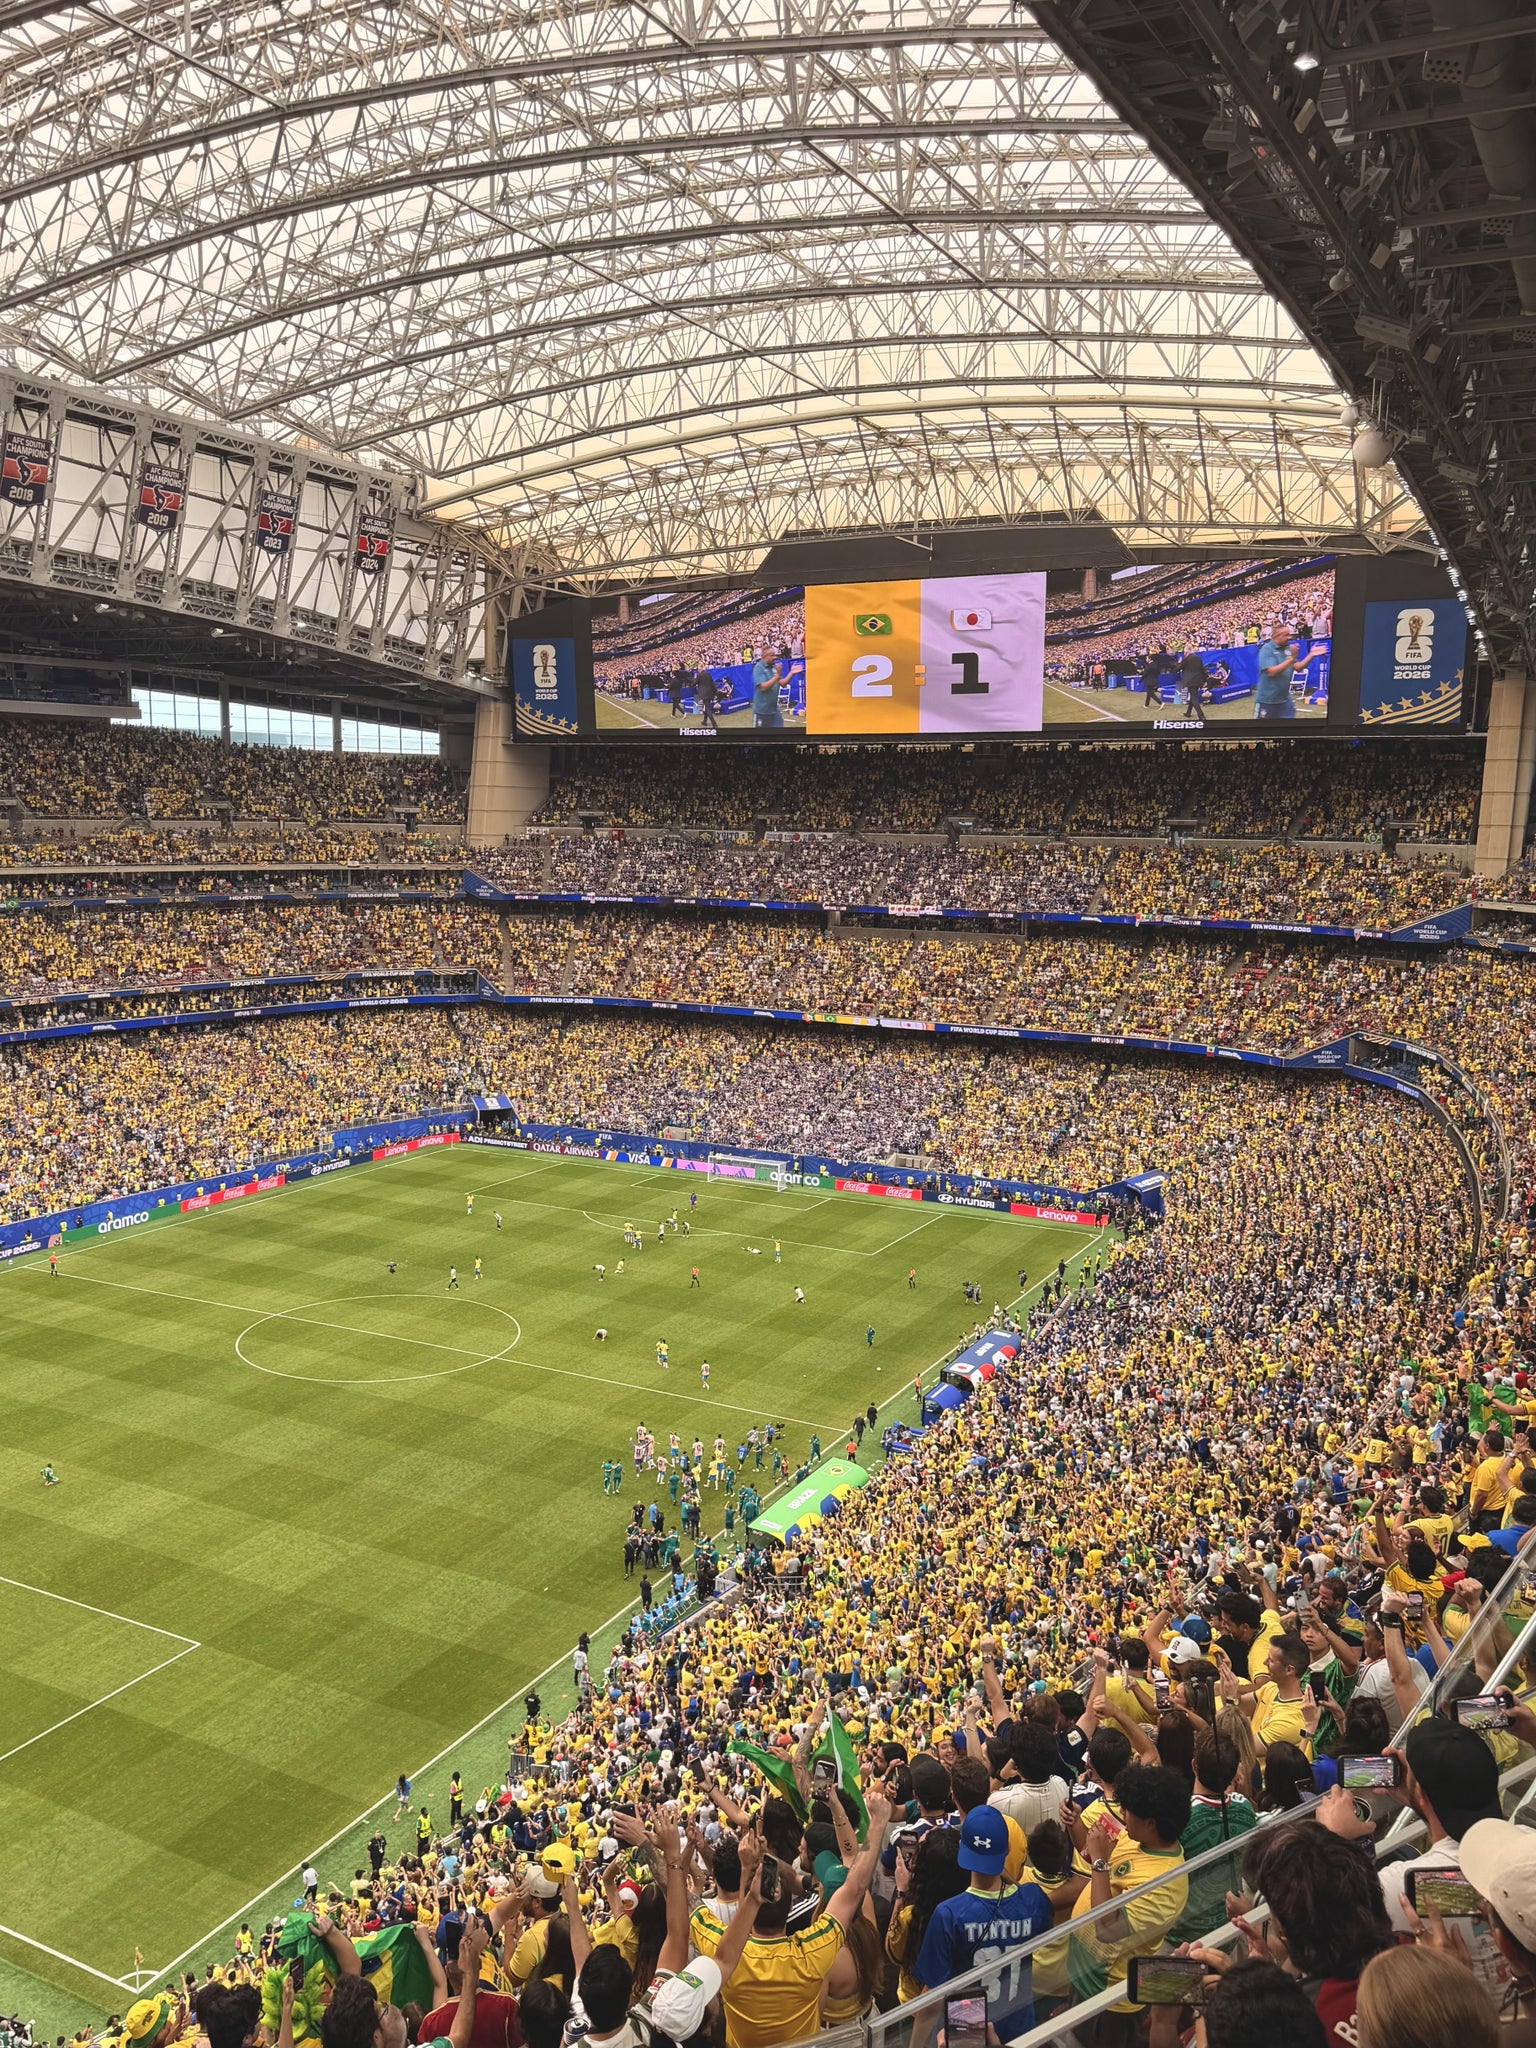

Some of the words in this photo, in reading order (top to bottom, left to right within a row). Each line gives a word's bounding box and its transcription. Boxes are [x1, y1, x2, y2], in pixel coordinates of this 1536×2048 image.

[12, 436, 24, 445] AFC
[25, 440, 46, 450] SOUTH
[6, 442, 49, 459] CHAMPIONS
[150, 466, 161, 475] AFC
[162, 469, 180, 479] SOUTH
[145, 472, 183, 488] CHAMPIONS
[9, 485, 34, 501] 2018
[267, 494, 277, 502] AFC
[277, 496, 292, 505] SOUTH
[262, 499, 294, 514] CHAMPIONS
[147, 511, 169, 527] 2019
[361, 522, 390, 535] CHAMPIONS
[263, 535, 282, 550] 2023
[360, 557, 379, 570] 2024
[851, 654, 894, 698] 2
[951, 652, 990, 695] 1
[1393, 670, 1431, 680] 2026
[1153, 719, 1204, 729] Hisense
[679, 727, 717, 736] Hisense
[230, 979, 266, 987] HOUSTON
[963, 1026, 985, 1034] WORLD
[1091, 1036, 1125, 1044] HOUSTON
[418, 1136, 444, 1148] Lenovo
[468, 1135, 483, 1144] ADI
[385, 1144, 409, 1157] Lenovo
[533, 1142, 561, 1154] QATAR
[564, 1145, 600, 1158] AIRWAYS
[627, 1152, 651, 1165] VISA
[275, 1162, 290, 1173] FIA
[323, 1159, 351, 1172] HYUNDAI
[770, 1171, 820, 1187] aramco
[975, 1180, 992, 1188] FIFA
[843, 1180, 869, 1193] Coca-Cola
[885, 1186, 912, 1199] Coca-Cola
[955, 1196, 995, 1209] HYUNDAI
[1036, 1207, 1078, 1223] Lenovo
[98, 1211, 149, 1234] aramco
[964, 1917, 1033, 1943] TUNTUN
